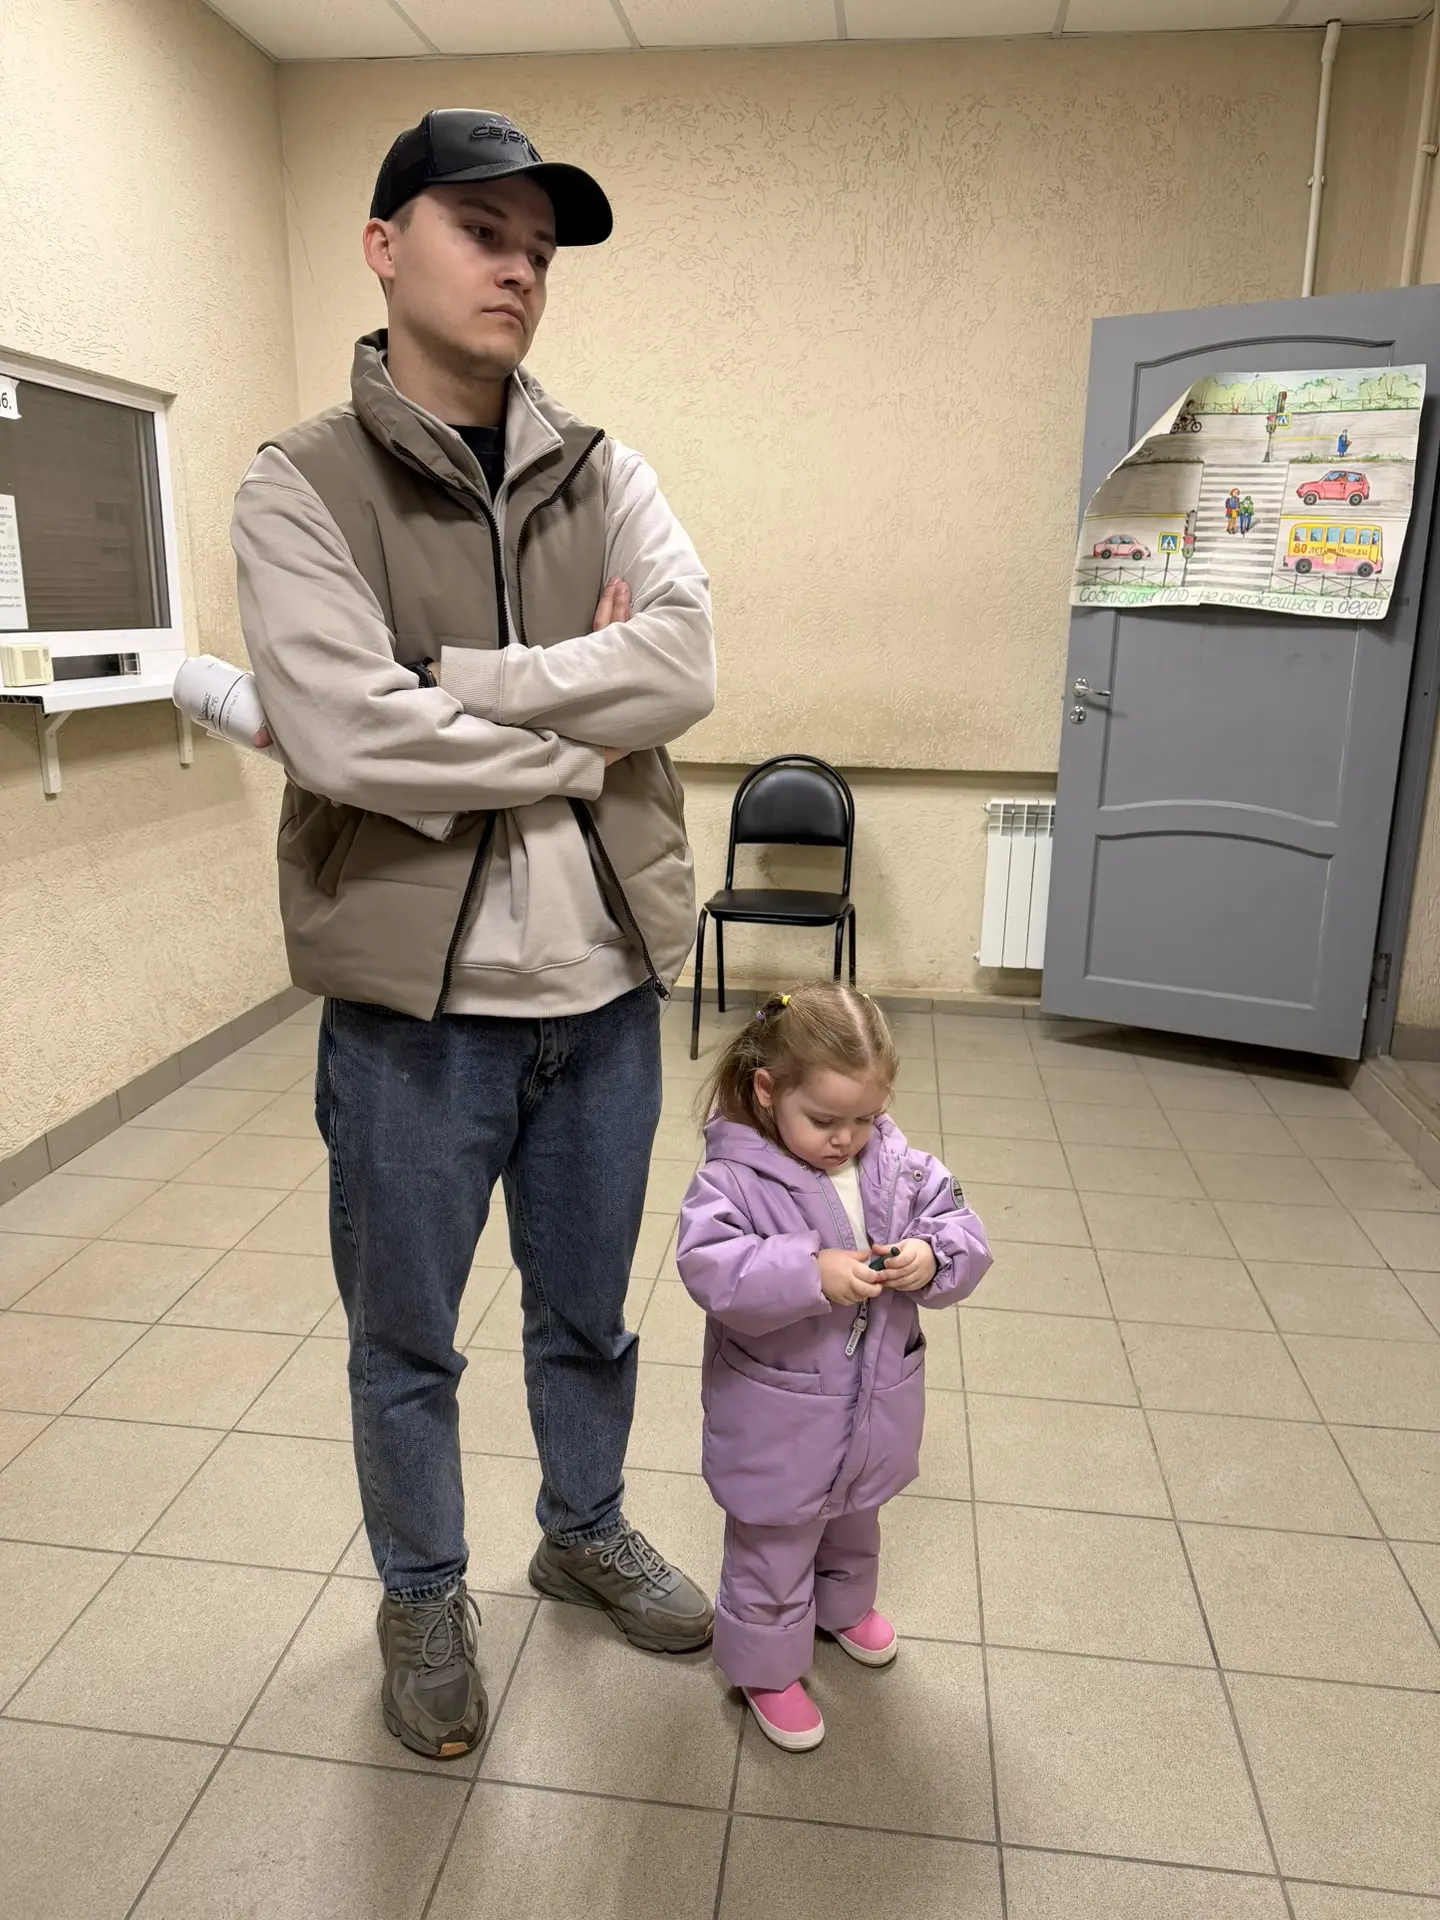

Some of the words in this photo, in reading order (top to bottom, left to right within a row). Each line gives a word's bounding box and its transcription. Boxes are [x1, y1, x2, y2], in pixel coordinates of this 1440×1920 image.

[1293, 543, 1307, 554] 80
[1079, 586, 1158, 604] Соблюдая
[1220, 591, 1317, 613] окажешься
[1322, 600, 1334, 614] в
[1338, 596, 1383, 618] беде!
